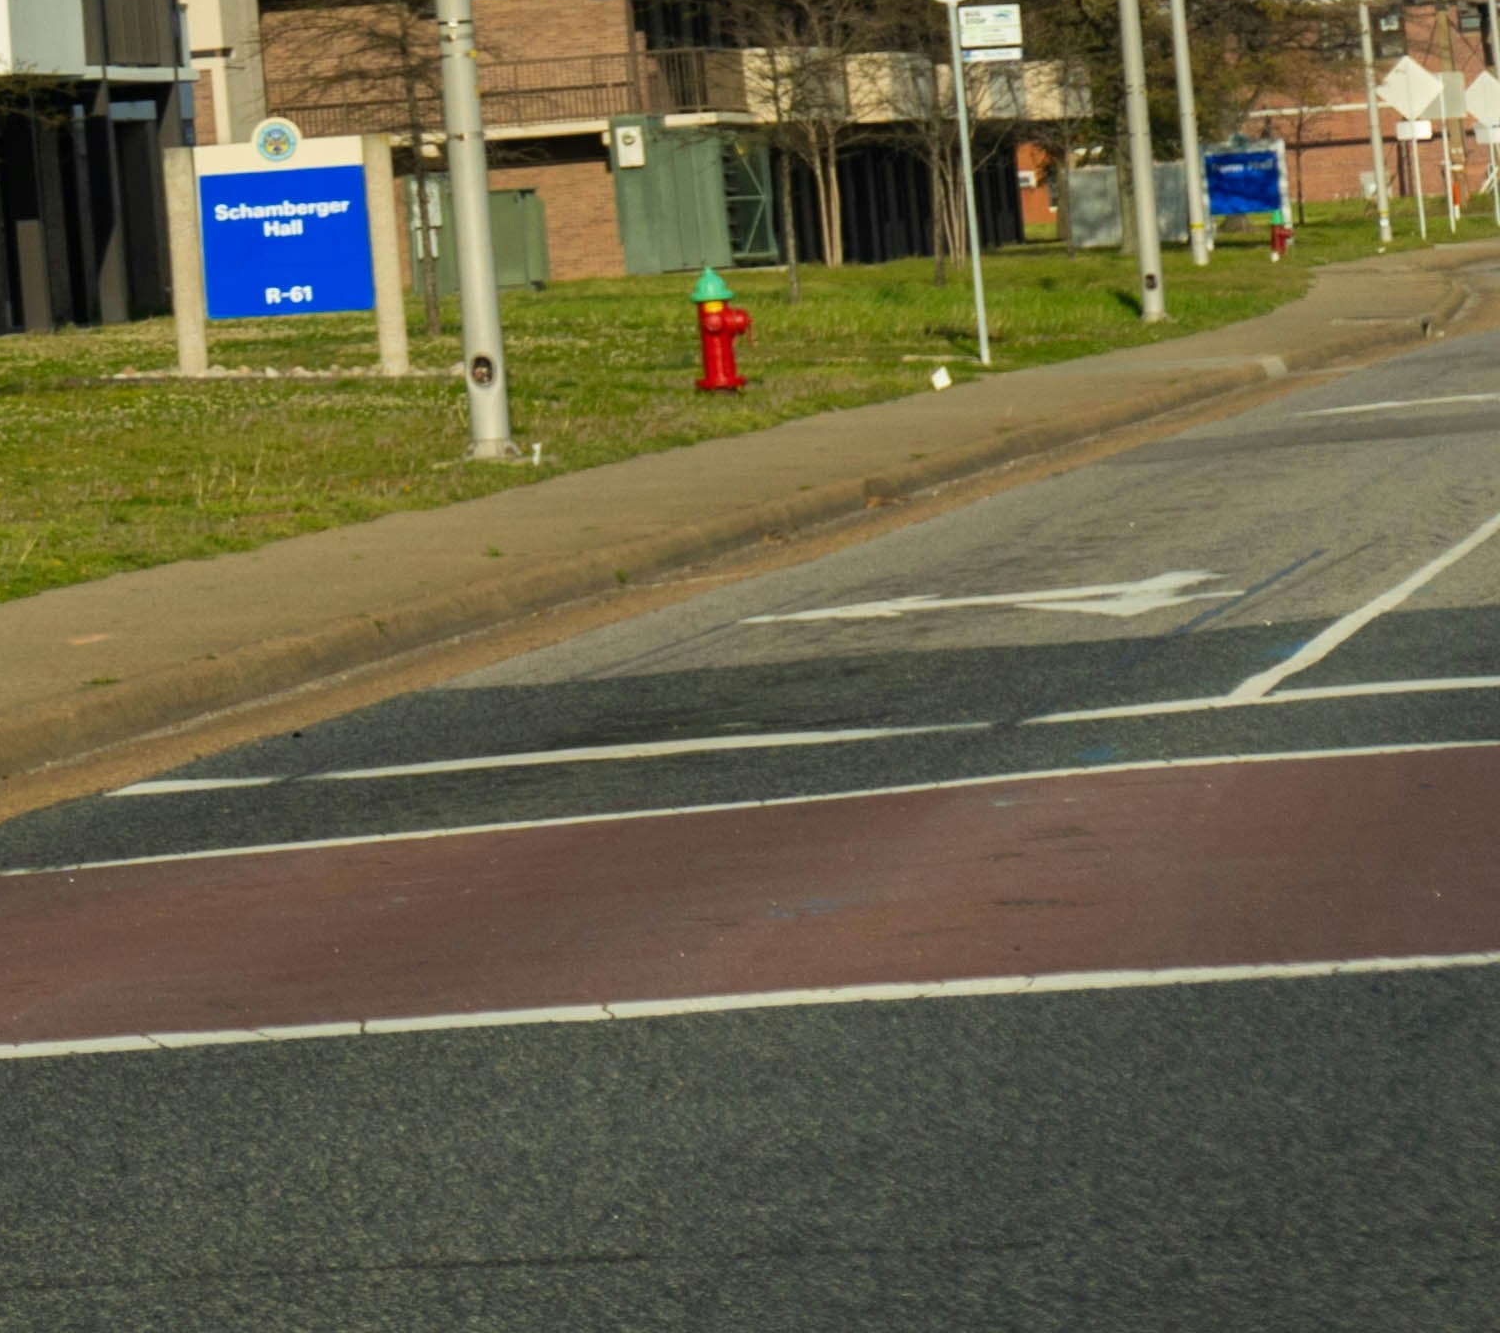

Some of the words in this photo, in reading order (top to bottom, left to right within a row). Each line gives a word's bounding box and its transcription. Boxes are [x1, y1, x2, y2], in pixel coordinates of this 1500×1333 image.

[213, 199, 350, 222] Schamberger
[263, 219, 304, 237] Hall
[265, 285, 314, 304] R-61
